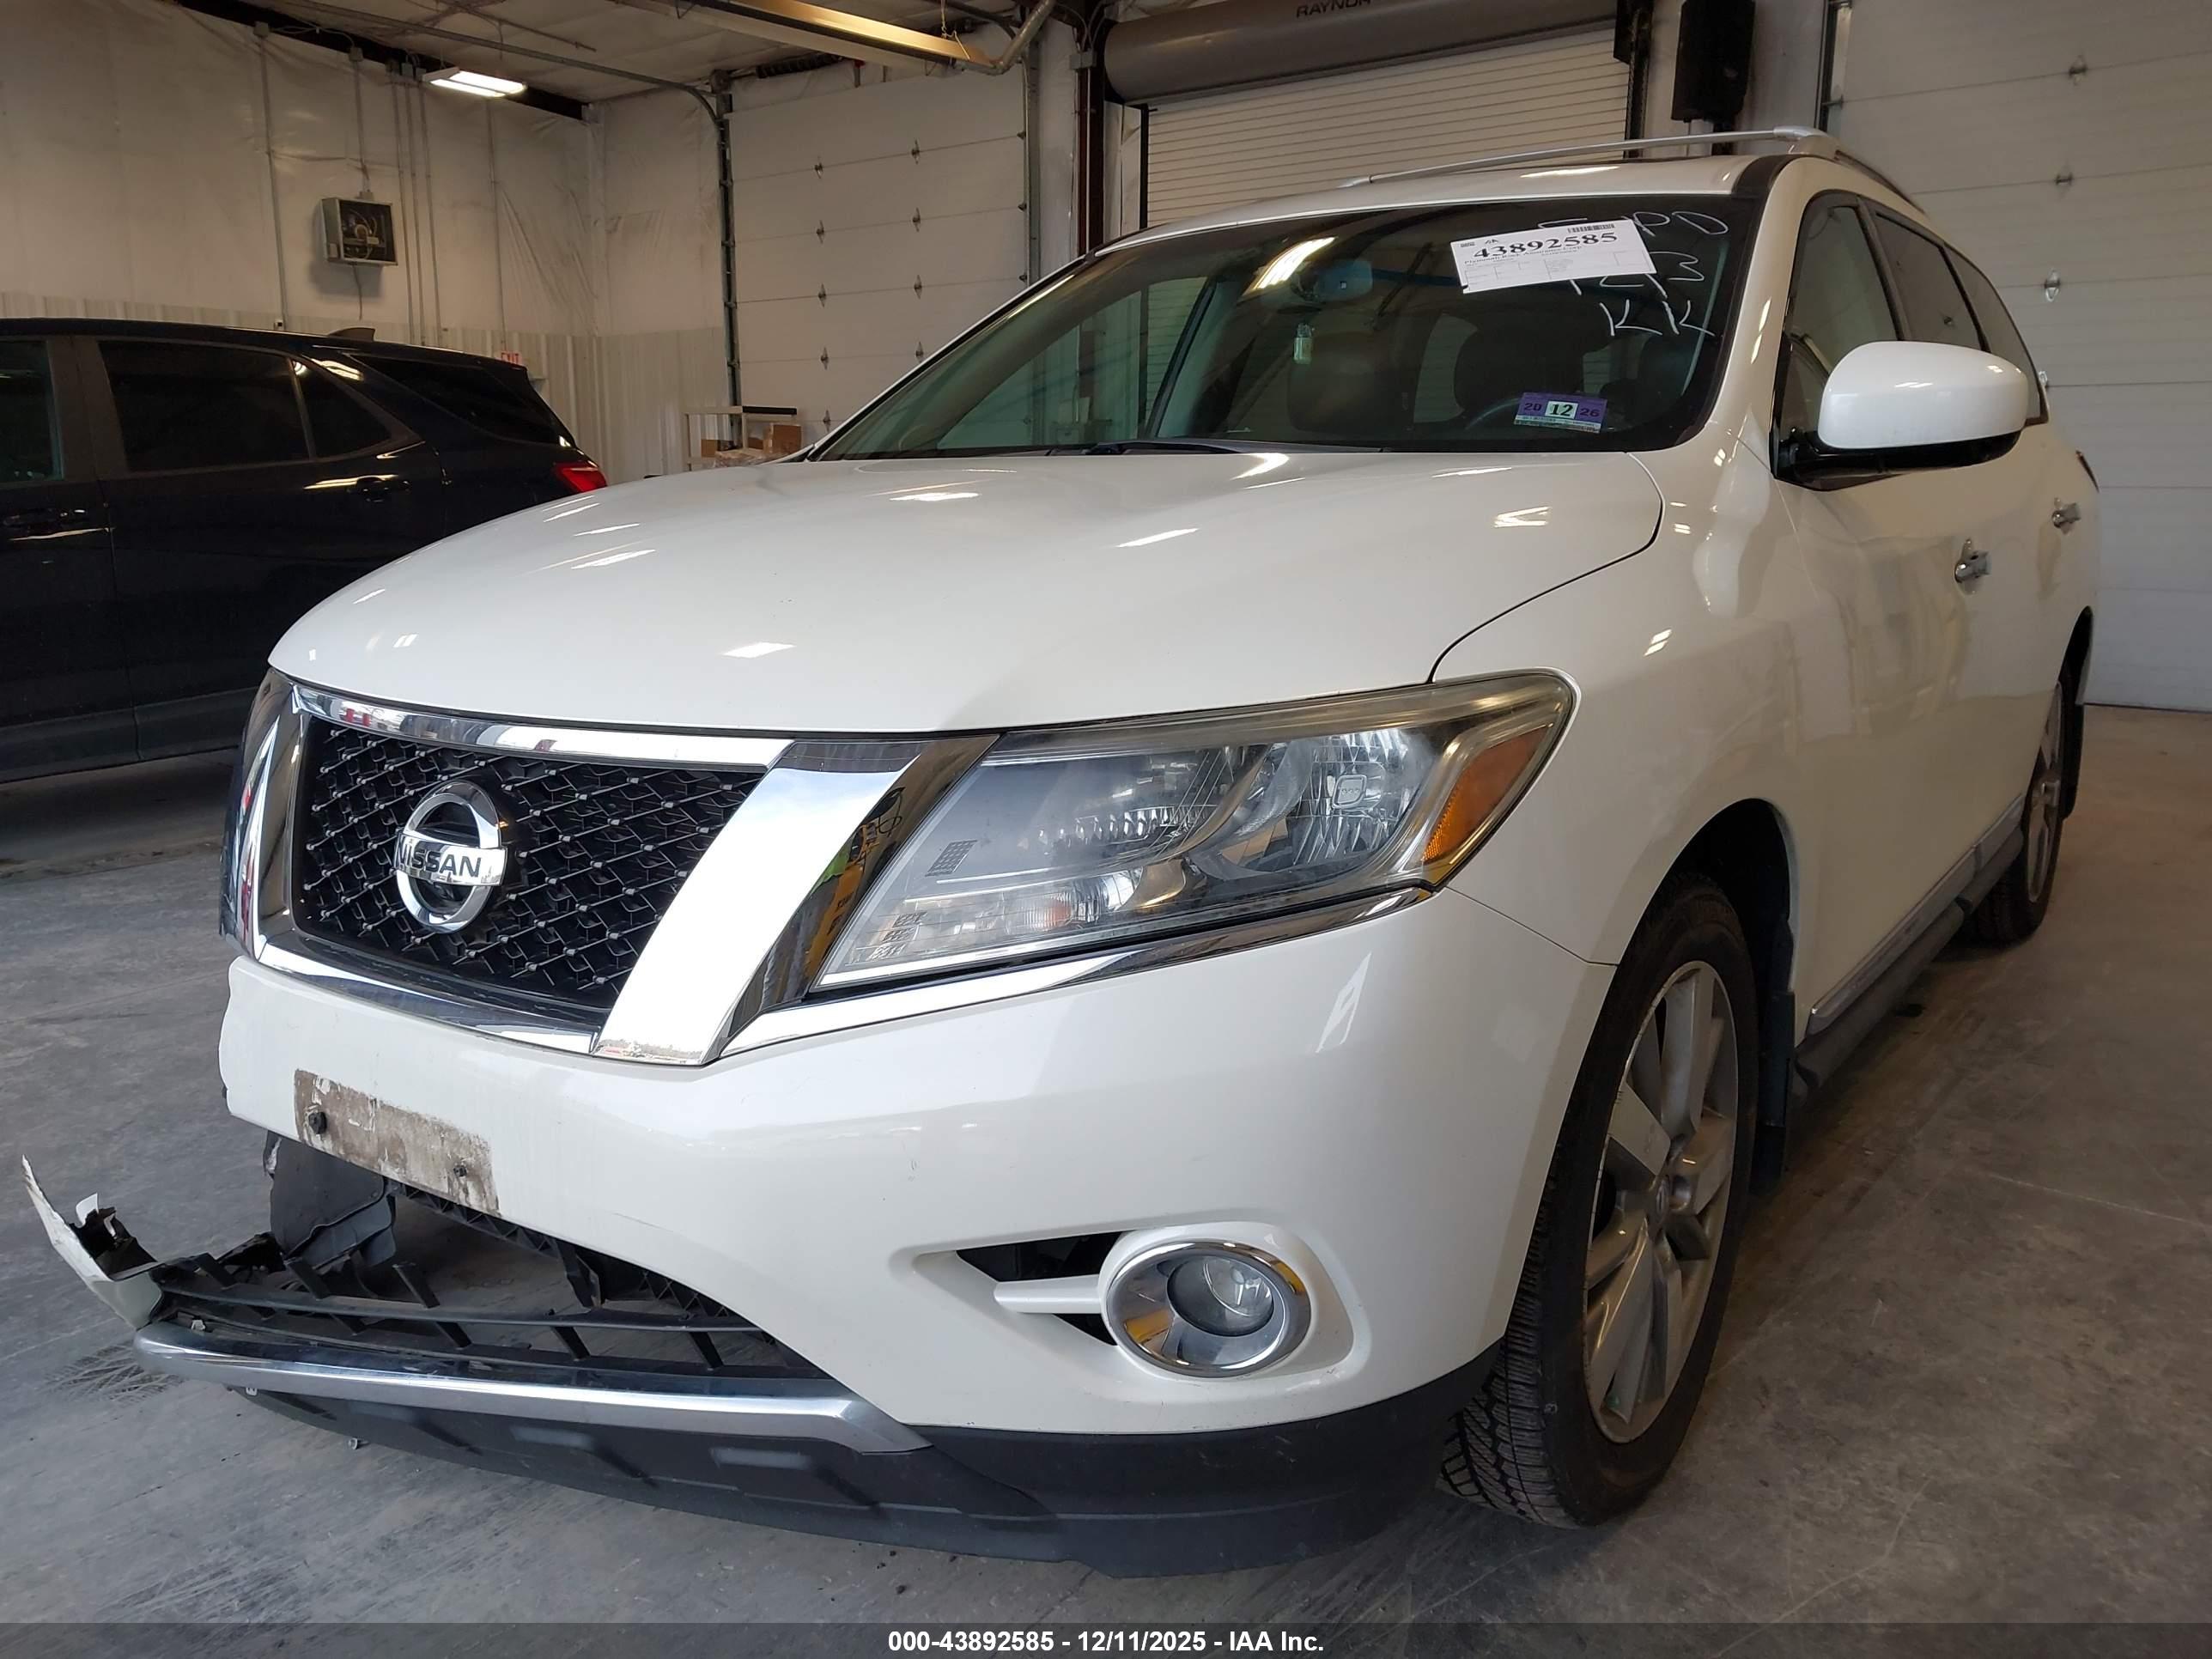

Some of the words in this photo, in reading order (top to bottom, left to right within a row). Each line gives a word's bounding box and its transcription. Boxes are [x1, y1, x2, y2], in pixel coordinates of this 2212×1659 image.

[1473, 232, 1618, 258] 43892585
[1550, 404, 1573, 416] 12
[1579, 407, 1601, 417] 26
[395, 835, 482, 878] NISSAN
